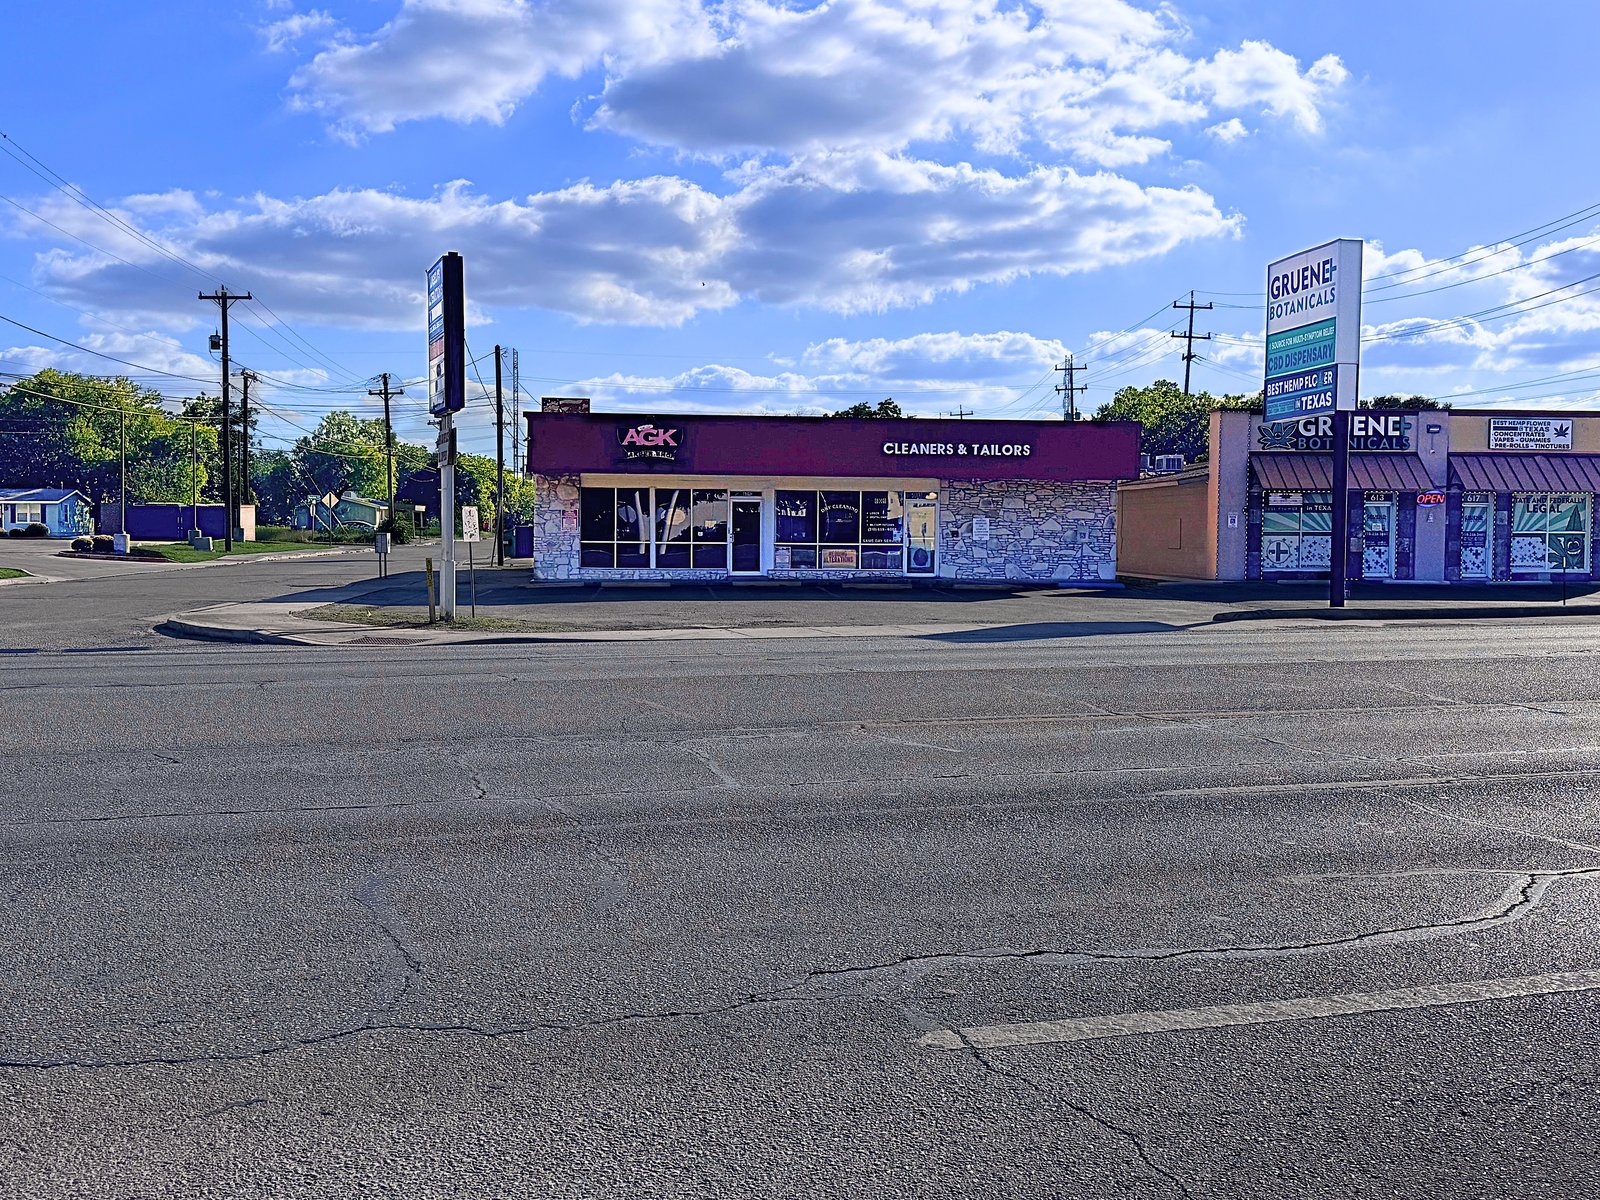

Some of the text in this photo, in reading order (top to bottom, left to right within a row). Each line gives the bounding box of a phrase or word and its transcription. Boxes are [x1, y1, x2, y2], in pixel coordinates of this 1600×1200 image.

[1269, 286, 1336, 321] BOTANICALS
[1271, 338, 1286, 350] SOURCE
[1285, 337, 1293, 346] FOR
[1292, 329, 1323, 345] MULTI-SYMPTOM
[1322, 326, 1335, 337] RELIEF
[1268, 343, 1334, 371] CBD DISPENSARY
[1267, 370, 1333, 397] BEST HEMP FLOER
[1301, 391, 1332, 411] TEXAS
[1297, 415, 1402, 436] GRENE
[620, 427, 679, 447] AGK
[1297, 436, 1410, 450] BOTNICALS
[882, 442, 1031, 457] CLEANERS & TAILORS
[1416, 493, 1446, 504] OPEN
[1526, 503, 1563, 514] LEGAL
[820, 505, 831, 514] DRY
[831, 503, 860, 515] CLEANING
